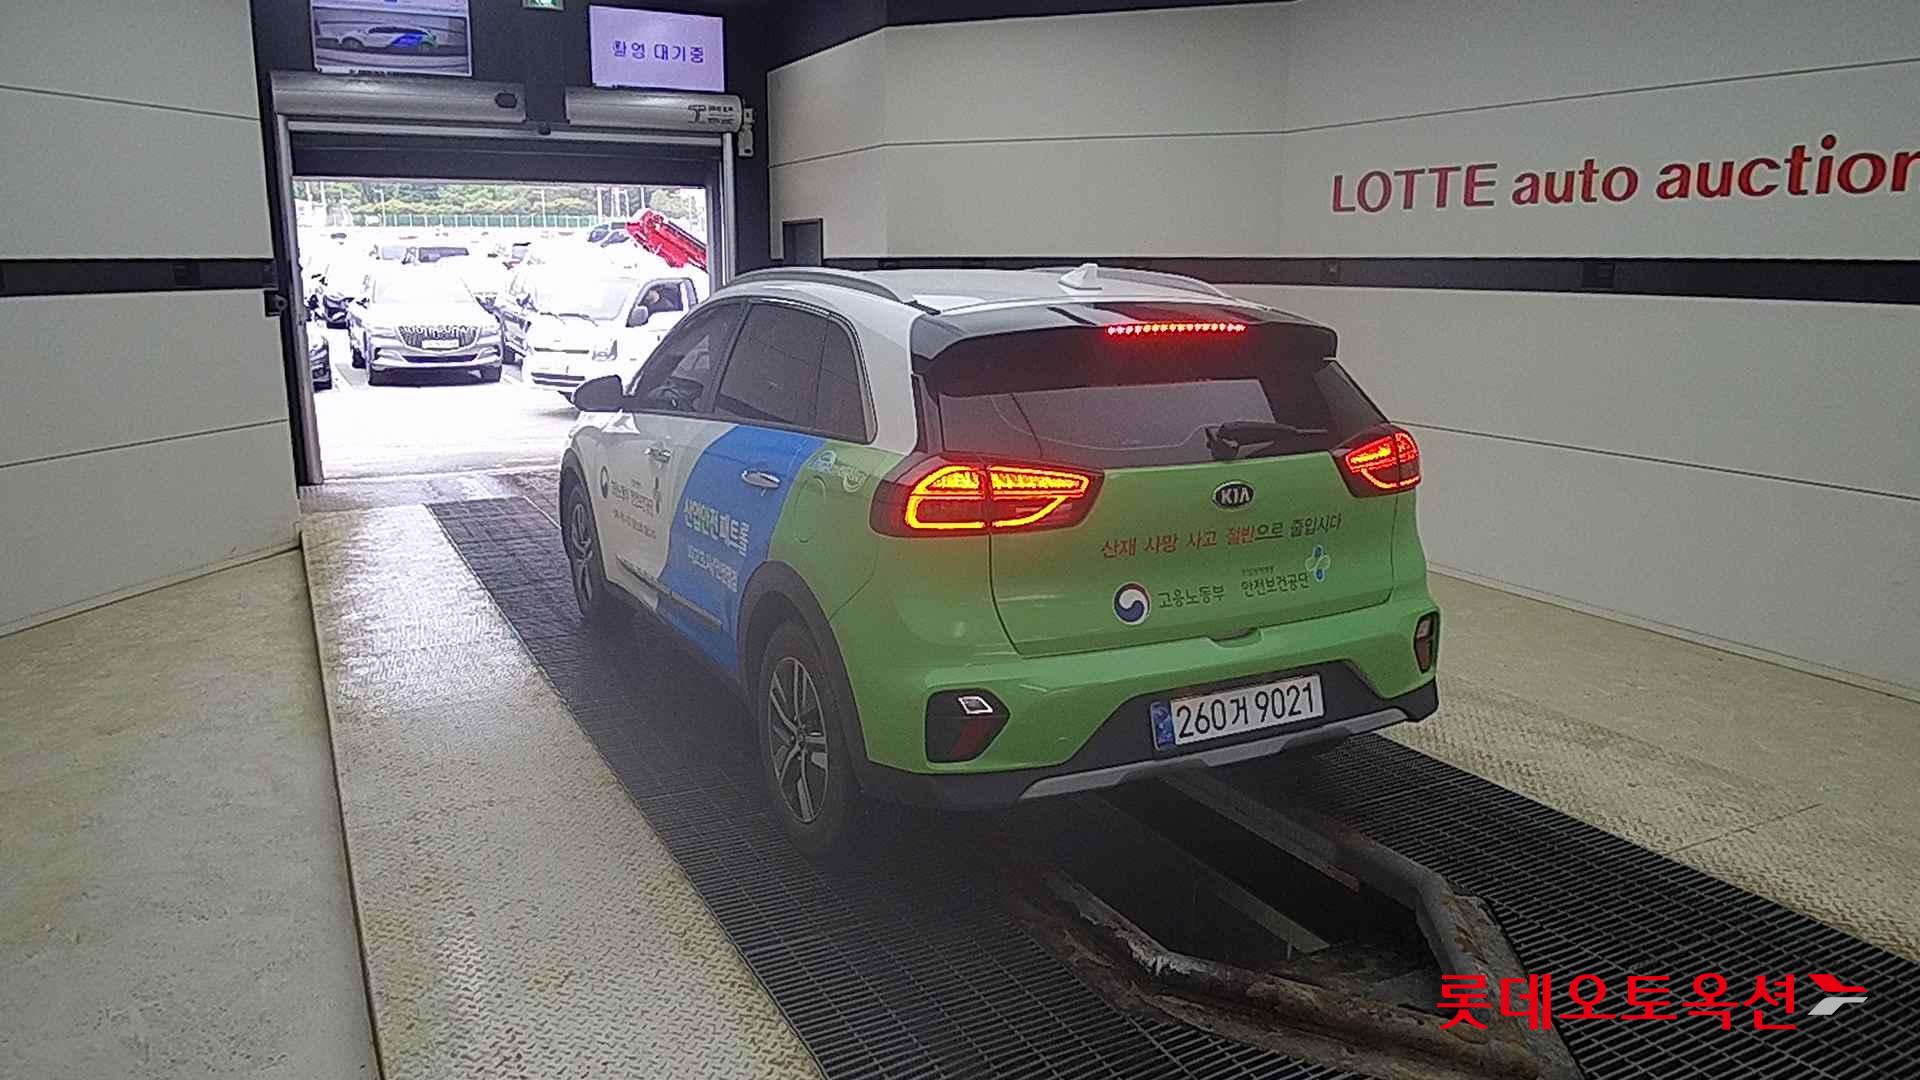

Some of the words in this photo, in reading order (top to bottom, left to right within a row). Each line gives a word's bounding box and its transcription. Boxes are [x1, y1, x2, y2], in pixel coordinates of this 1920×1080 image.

[654, 44, 704, 64] 대기중
[1332, 163, 1498, 212] LOTTE
[1512, 158, 1639, 205] auto
[1221, 487, 1250, 505] KIA
[1101, 537, 1137, 559] 산재
[1143, 533, 1178, 555] 사망
[1185, 530, 1217, 551] 사고
[1290, 512, 1343, 538] 줄입시다
[1158, 585, 1226, 609] 고용노동부
[1241, 572, 1310, 598] 안전보건공단
[1176, 695, 1249, 739] 260거
[1255, 682, 1314, 723] 9021
